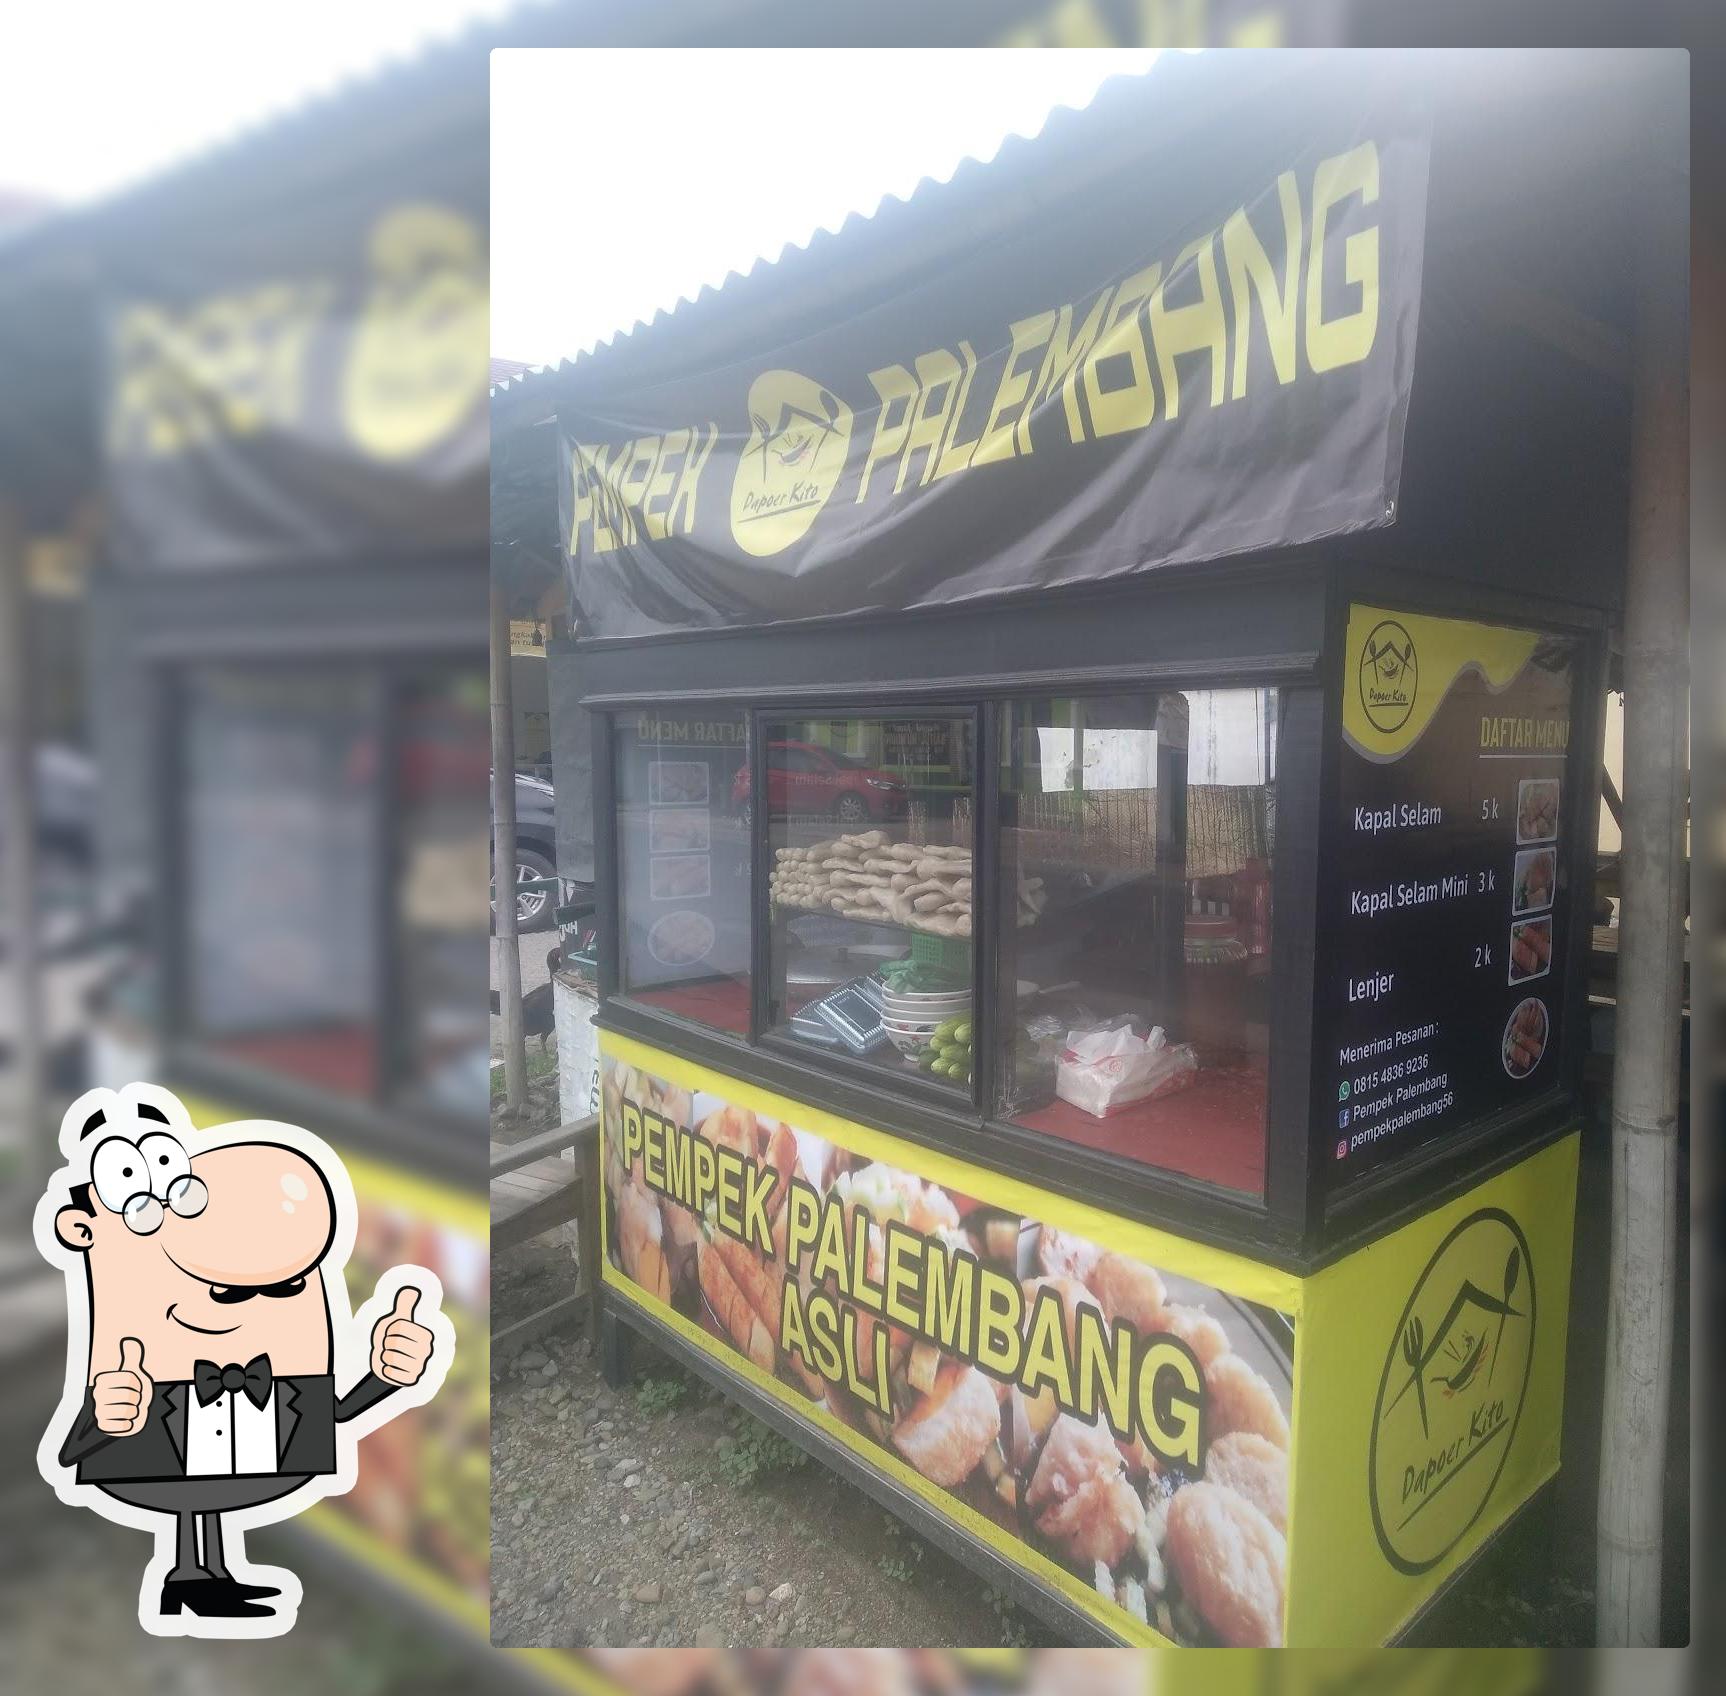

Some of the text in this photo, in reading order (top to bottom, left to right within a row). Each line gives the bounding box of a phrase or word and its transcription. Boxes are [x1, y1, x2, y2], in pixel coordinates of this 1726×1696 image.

[855, 140, 1381, 505] PALEMBANG
[789, 481, 819, 502] Kito
[1480, 717, 1570, 749] DAFTAR MENU
[1354, 804, 1396, 835] Kapal
[1400, 802, 1441, 828] Selam
[1351, 885, 1394, 918] Kapal
[1397, 881, 1438, 907] Selam
[1442, 874, 1469, 899] Mini
[1349, 971, 1395, 1002] Lenjer
[1340, 1037, 1393, 1066] Menerima
[1353, 1053, 1429, 1095] 0815 4836 9236
[1353, 1072, 1448, 1121] Pempek Palembang
[1350, 1091, 1454, 1152] pempekpalembang56
[621, 1104, 1202, 1467] PEMPEK PALEMBANG
[780, 1275, 895, 1419] ASLI
[1402, 1400, 1505, 1504] Dapoer Kito
